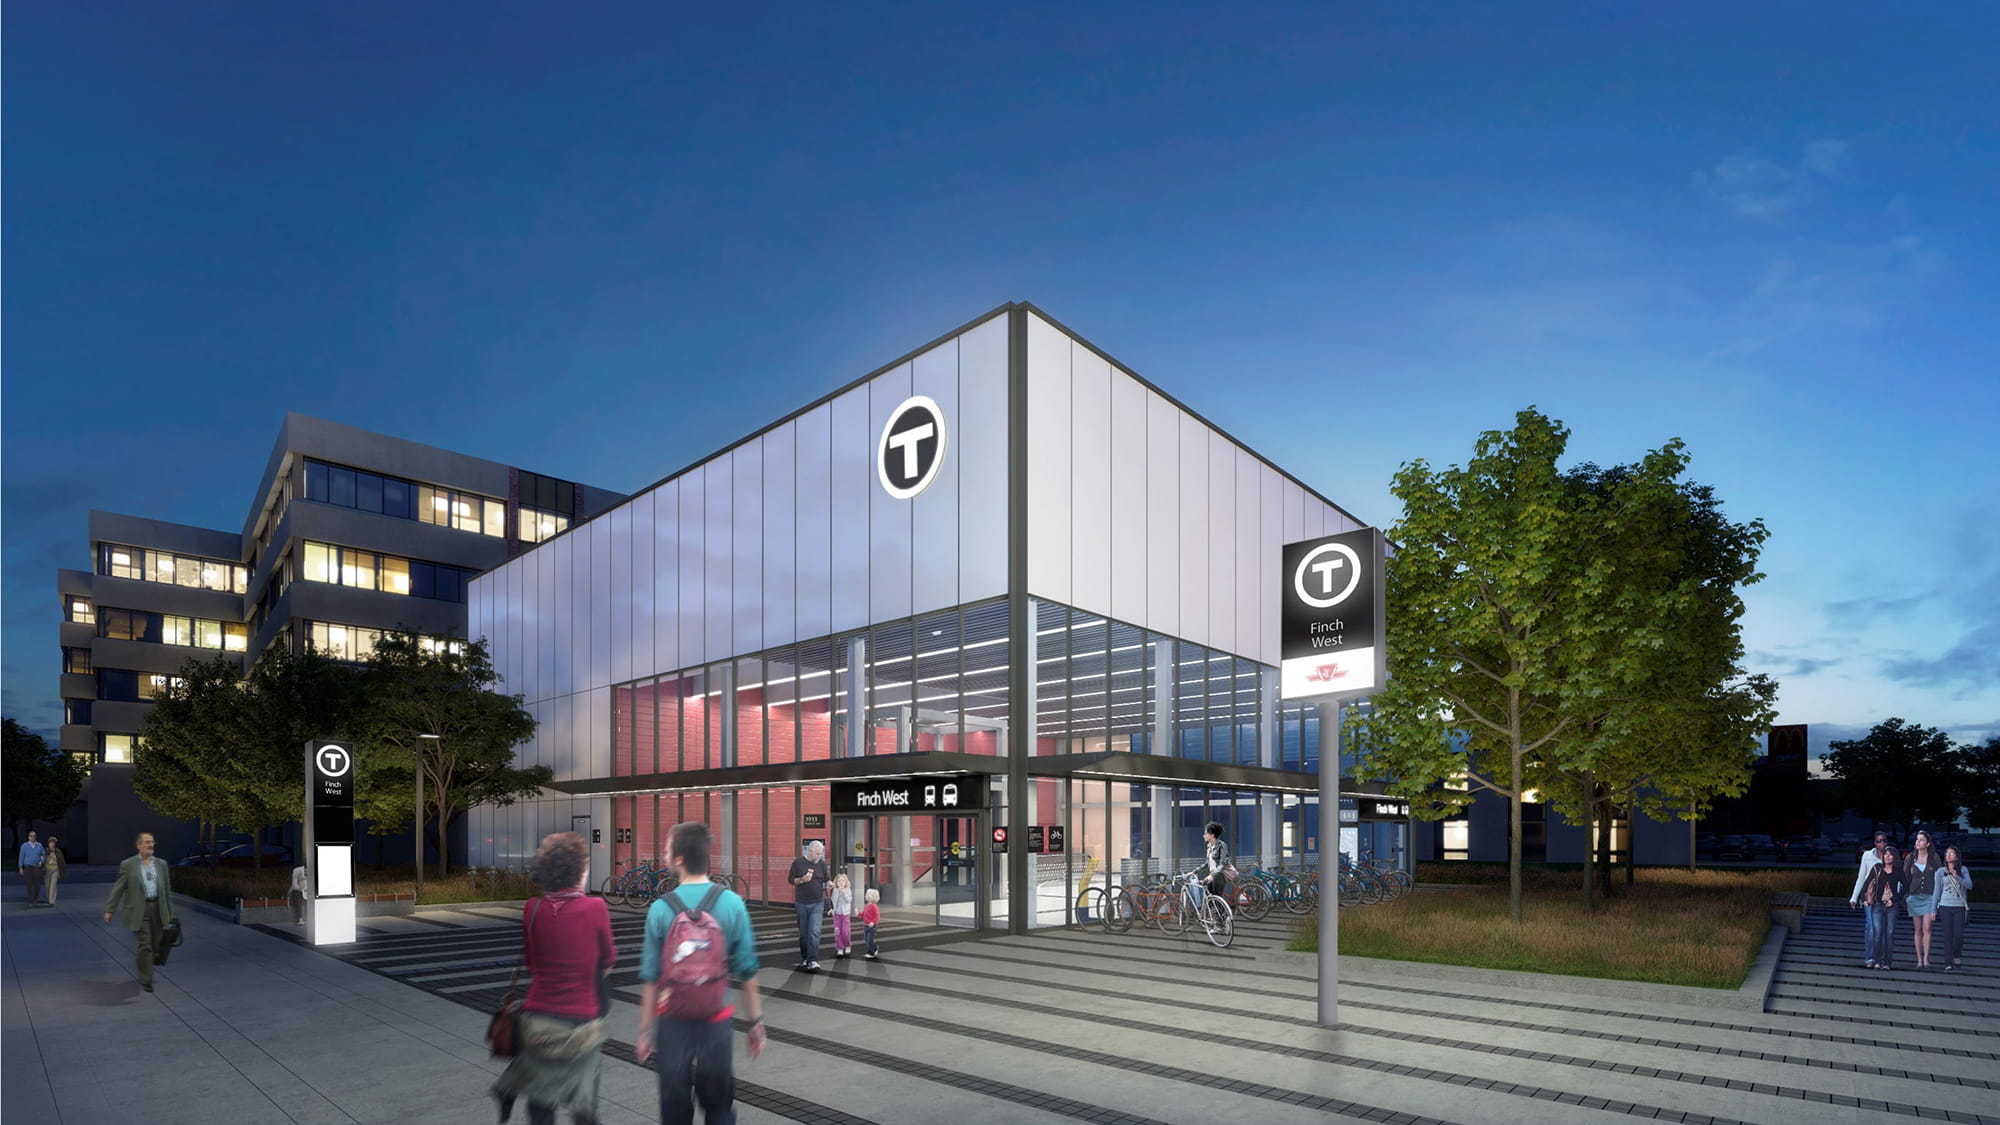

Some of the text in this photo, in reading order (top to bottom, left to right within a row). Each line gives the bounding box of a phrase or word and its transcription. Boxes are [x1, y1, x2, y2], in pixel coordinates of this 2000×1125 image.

[889, 421, 934, 480] T
[1311, 558, 1344, 594] T
[1310, 618, 1344, 635] Finch
[1311, 634, 1343, 649] West
[325, 753, 341, 770] T
[857, 789, 909, 807] Finch West
